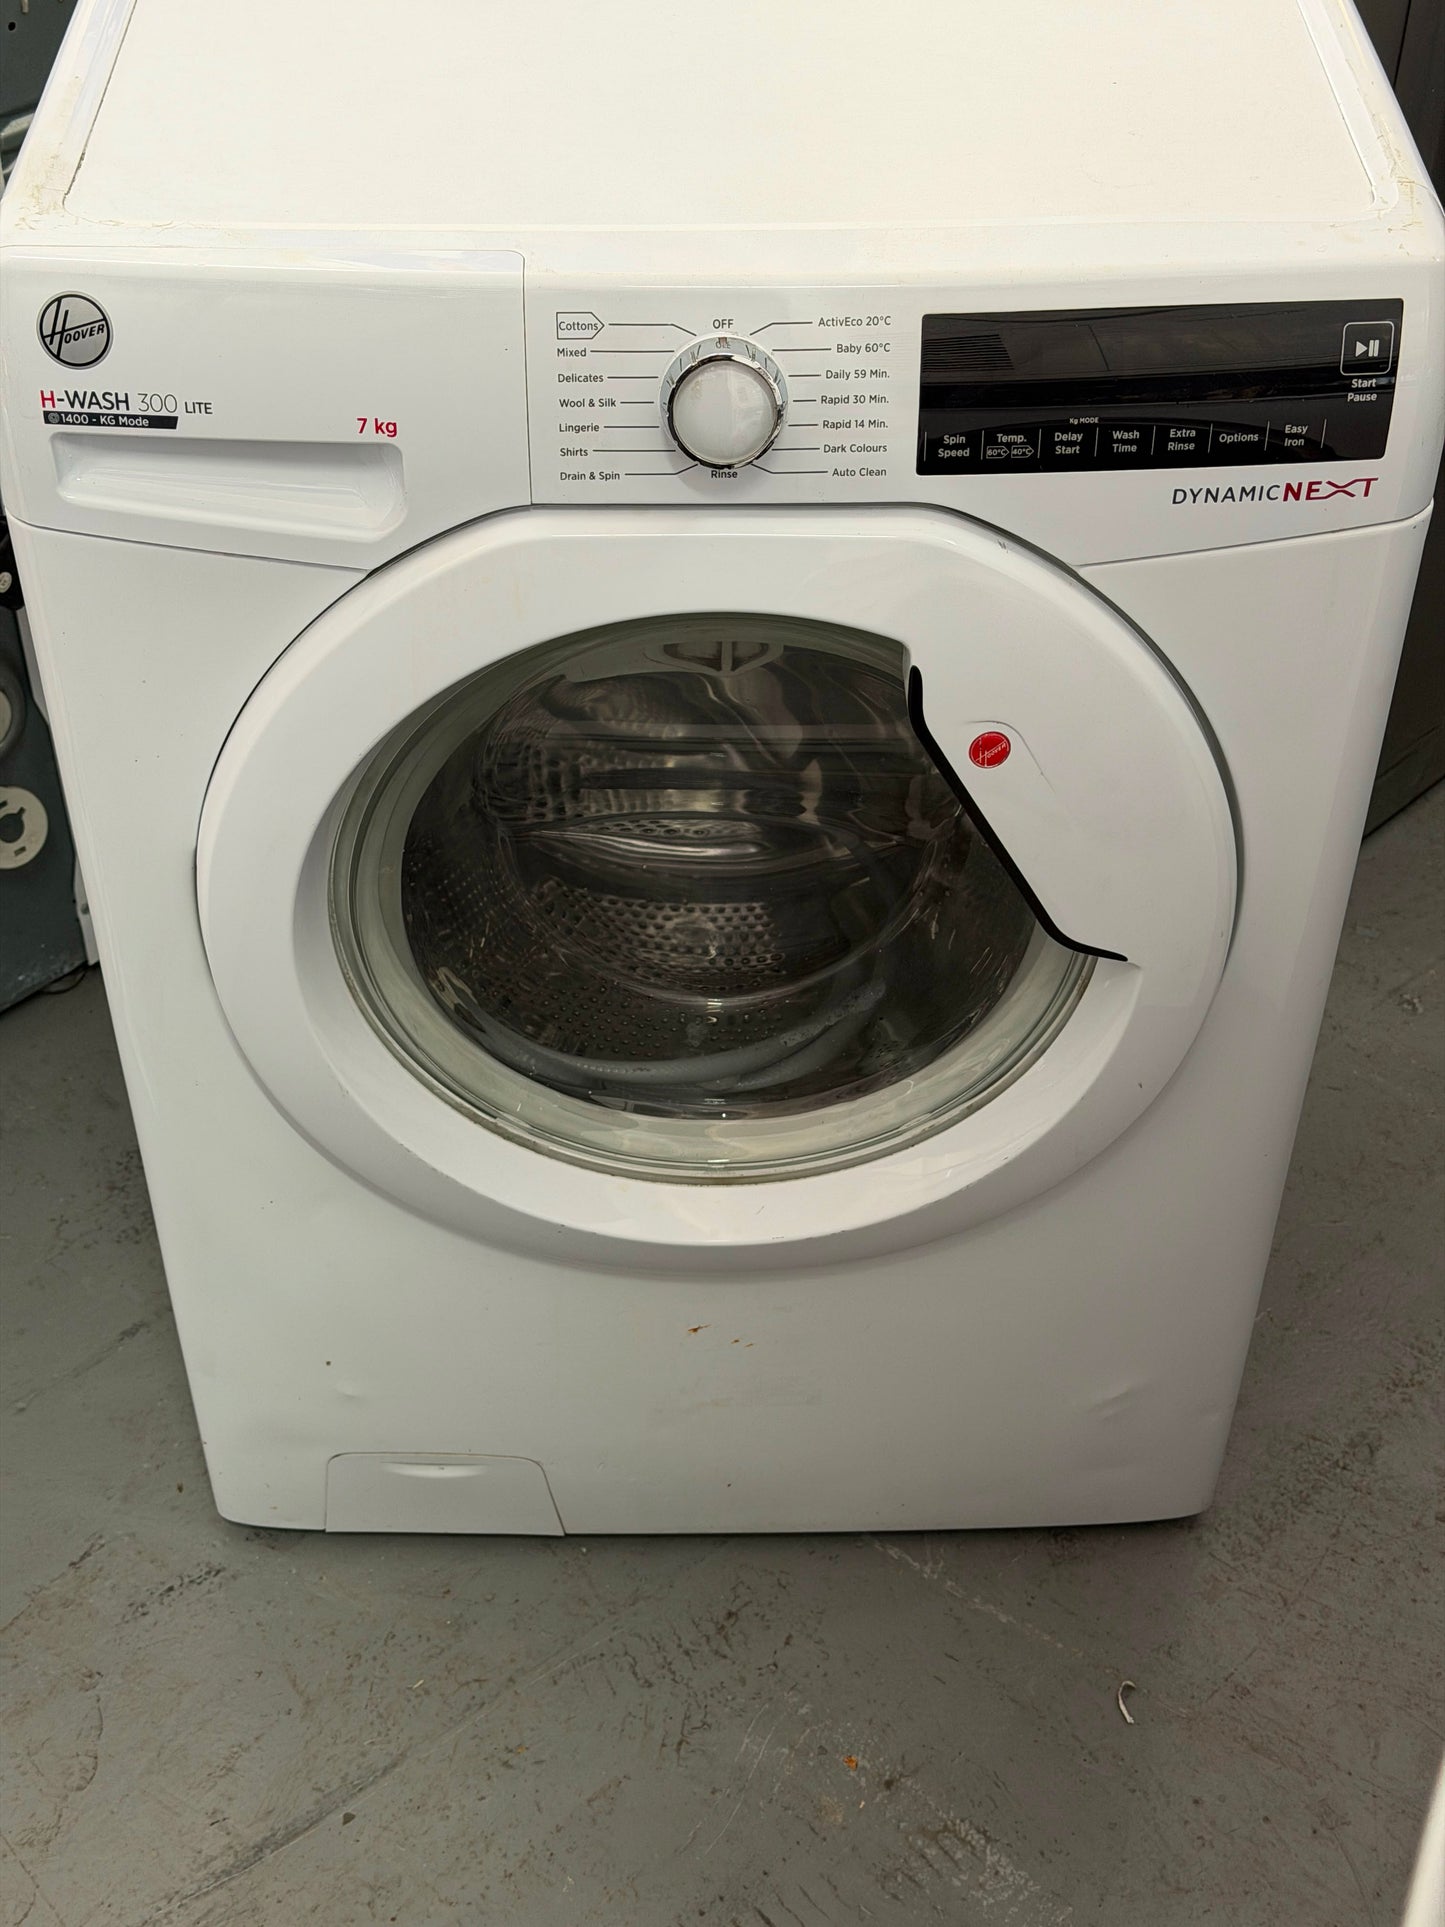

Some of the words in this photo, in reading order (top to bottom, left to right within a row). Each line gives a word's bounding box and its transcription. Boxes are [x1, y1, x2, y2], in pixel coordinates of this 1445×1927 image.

[559, 321, 599, 331] Cottons
[713, 319, 734, 329] OFF
[818, 317, 863, 327] ActivEco
[866, 316, 891, 326] 20°C
[44, 300, 105, 358] HOOVER
[557, 347, 587, 357] Mixed
[837, 343, 861, 354] Baby
[865, 343, 891, 353] 60°C
[558, 373, 604, 383] Delicates
[826, 370, 851, 381] Daily
[854, 369, 867, 379] 59
[870, 369, 890, 378] Min.
[1352, 378, 1376, 388] Start
[40, 390, 130, 412] H-WASH
[138, 393, 178, 413] 300
[185, 402, 212, 414] LITE
[821, 395, 849, 406] Rapid
[853, 395, 867, 404] 30
[870, 395, 889, 404] Min.
[1348, 393, 1377, 401] Pause
[559, 399, 585, 408] Wool
[588, 399, 595, 408] &
[598, 398, 616, 407] Silk
[62, 414, 88, 426] 1400
[100, 416, 115, 425] KG
[119, 416, 149, 427] Mode
[823, 420, 851, 431] Rapid
[854, 420, 866, 429] 14
[869, 419, 888, 429] Min.
[357, 418, 367, 433] 7
[375, 418, 397, 438] kg
[559, 423, 599, 434] Lingerie
[1170, 429, 1196, 437] Extra
[1285, 425, 1308, 434] Easy
[997, 434, 1027, 443] Temp.
[1055, 432, 1083, 442] Delay
[1112, 430, 1140, 439] Wash
[1219, 433, 1259, 443] Options
[943, 435, 965, 445] Spin
[1285, 438, 1304, 446] Iron
[824, 443, 846, 453] Dark
[849, 443, 887, 453] Colours
[1055, 445, 1080, 454] Start
[1112, 444, 1137, 452] Time
[1168, 442, 1195, 450] Rinse
[560, 448, 588, 457] Shirts
[938, 448, 970, 457] Speed
[560, 471, 586, 481] Drain
[589, 471, 596, 480] &
[599, 471, 620, 483] Spin
[711, 469, 737, 479] Rinse
[832, 468, 855, 477] Auto
[859, 467, 886, 477] Clean
